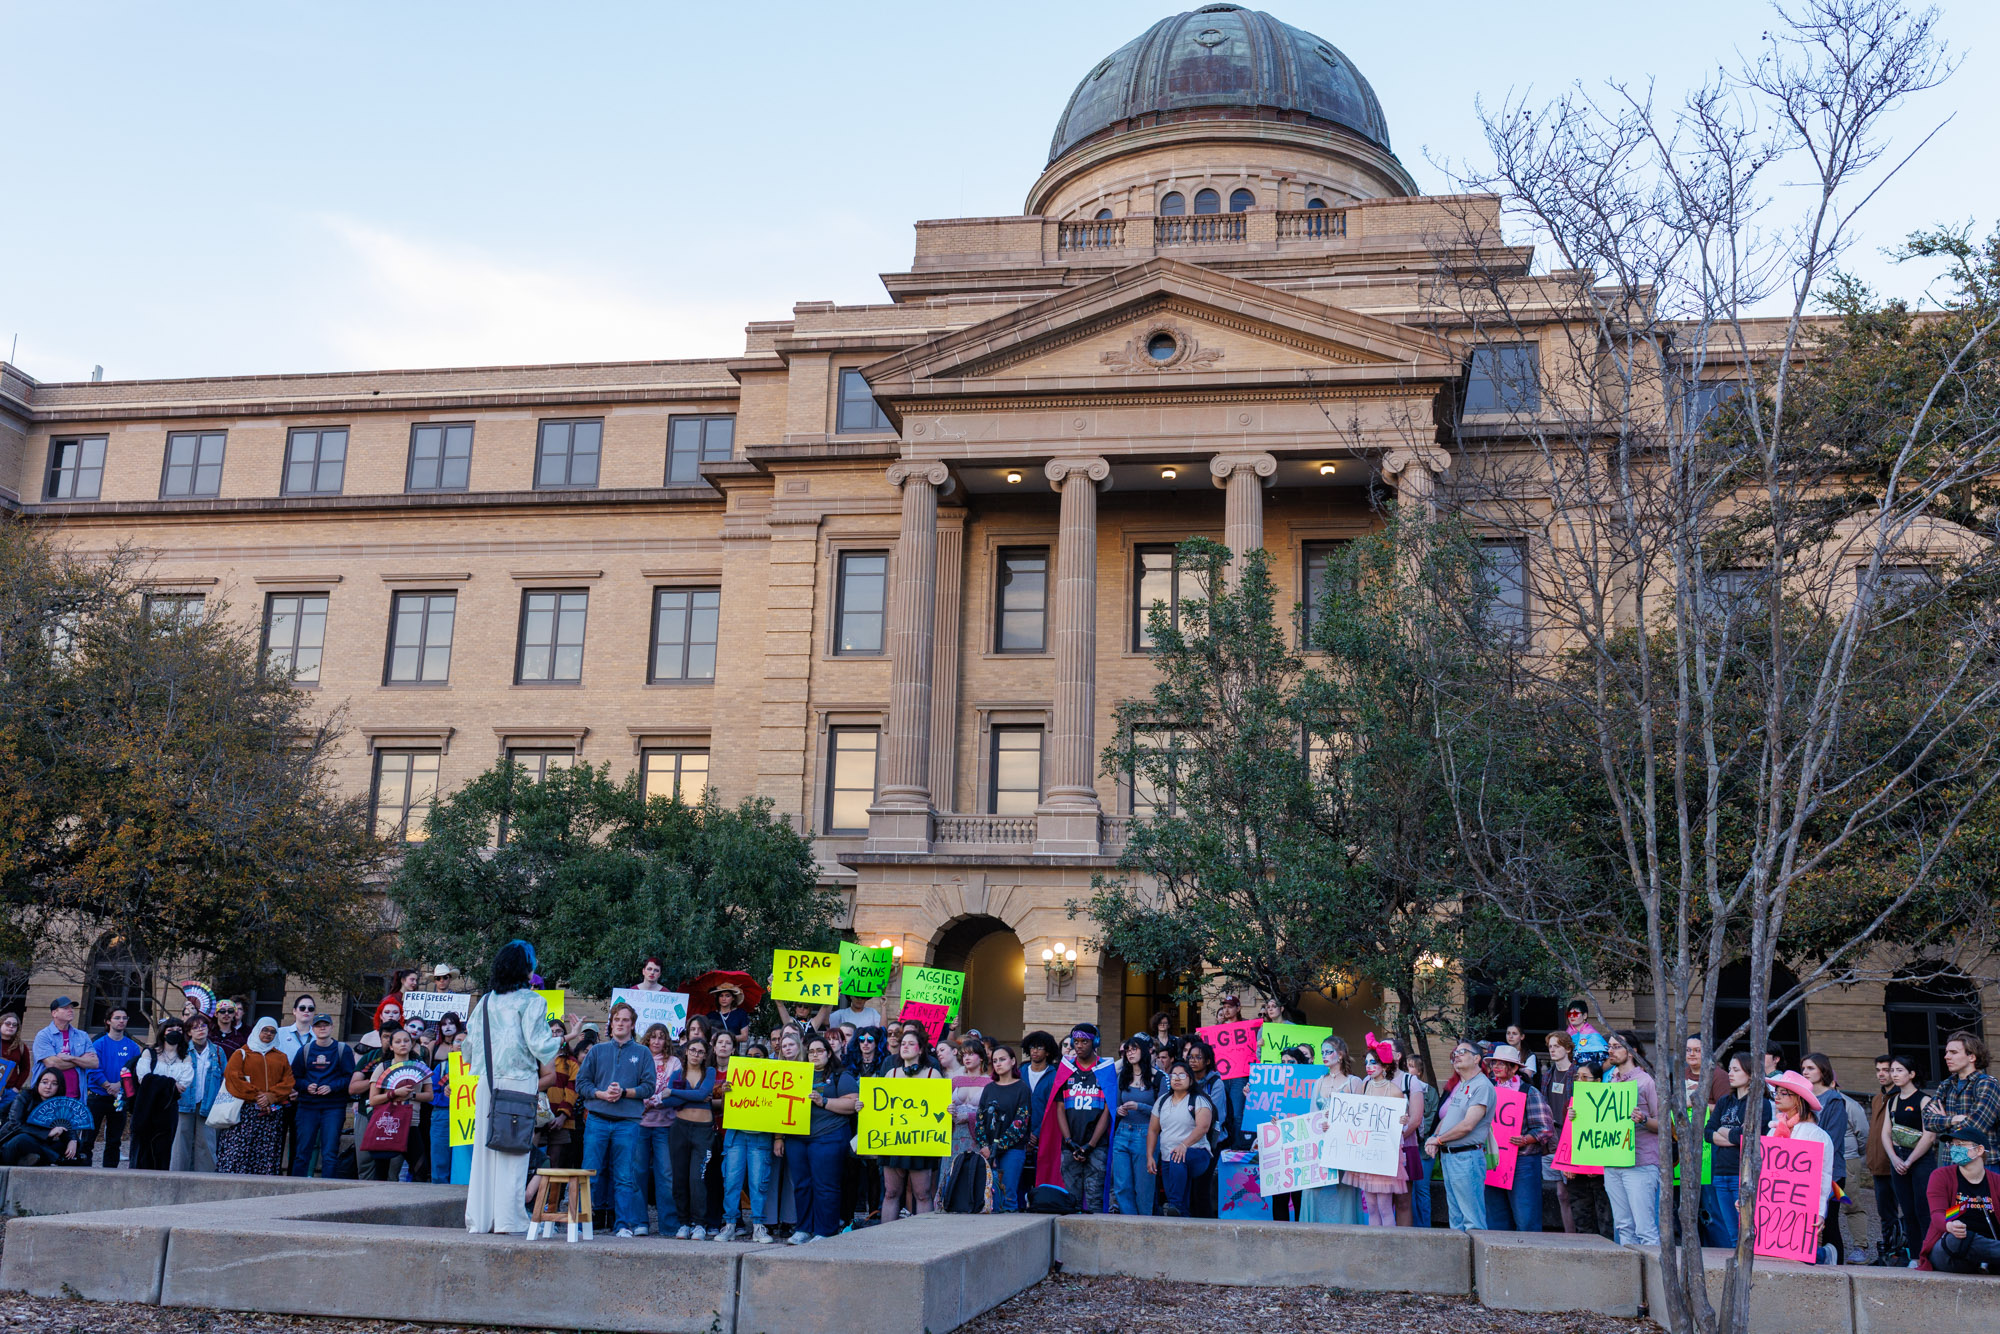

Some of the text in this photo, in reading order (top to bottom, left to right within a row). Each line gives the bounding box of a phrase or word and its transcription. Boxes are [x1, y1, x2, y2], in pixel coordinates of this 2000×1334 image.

[788, 955, 831, 969] DRAG
[850, 949, 888, 963] Y'ALL
[783, 971, 804, 982] IS
[847, 966, 885, 977] MEANS
[916, 969, 960, 986] AGGIES
[800, 984, 833, 996] ART
[845, 979, 877, 993] ALL
[937, 985, 958, 994] FREE
[405, 993, 425, 1001] FREE
[426, 993, 454, 1002] SPEECH
[404, 1009, 467, 1020] TRADITN
[731, 1068, 794, 1090] NO LGB
[1249, 1064, 1294, 1085] STOP
[1069, 1082, 1099, 1096] Pride
[1283, 1078, 1316, 1099] HAT
[761, 1098, 773, 1108] the
[873, 1087, 928, 1117] Drag
[1074, 1095, 1093, 1110] 02
[1244, 1091, 1284, 1111] SAVE
[1586, 1086, 1632, 1123] Y'ALL
[890, 1113, 908, 1126] is
[1331, 1096, 1396, 1132] DRAG IS ART
[868, 1129, 950, 1149] BEAUTIFUL
[1263, 1113, 1323, 1148] DRAG
[1346, 1129, 1372, 1147] NOT
[1577, 1129, 1621, 1151] MEANS
[1265, 1163, 1338, 1189] OF SPEECH
[1758, 1178, 1810, 1206] REE
